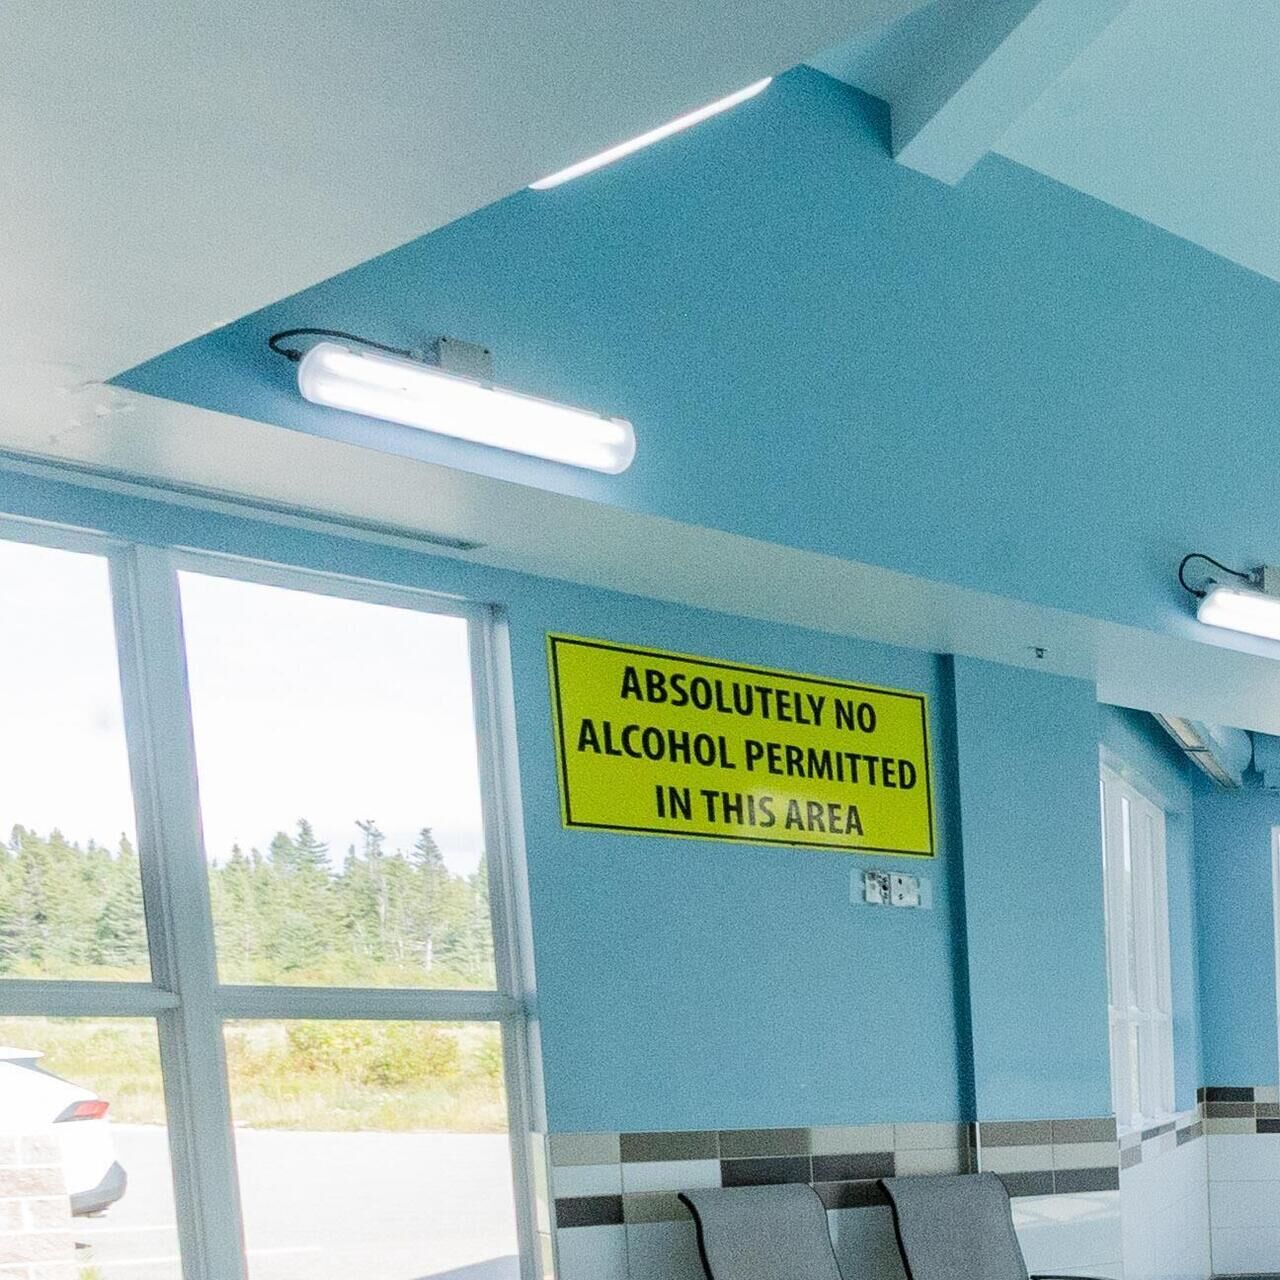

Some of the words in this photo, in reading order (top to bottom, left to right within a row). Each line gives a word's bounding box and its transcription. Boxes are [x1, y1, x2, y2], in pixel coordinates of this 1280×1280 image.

[620, 665, 826, 725] ABSOLUTELY
[835, 697, 877, 734] NO
[577, 719, 736, 769] ALCOHOL
[746, 740, 917, 790] PERMITTED
[655, 785, 692, 820] IN
[701, 790, 775, 828] THIS
[785, 799, 864, 836] AREA
